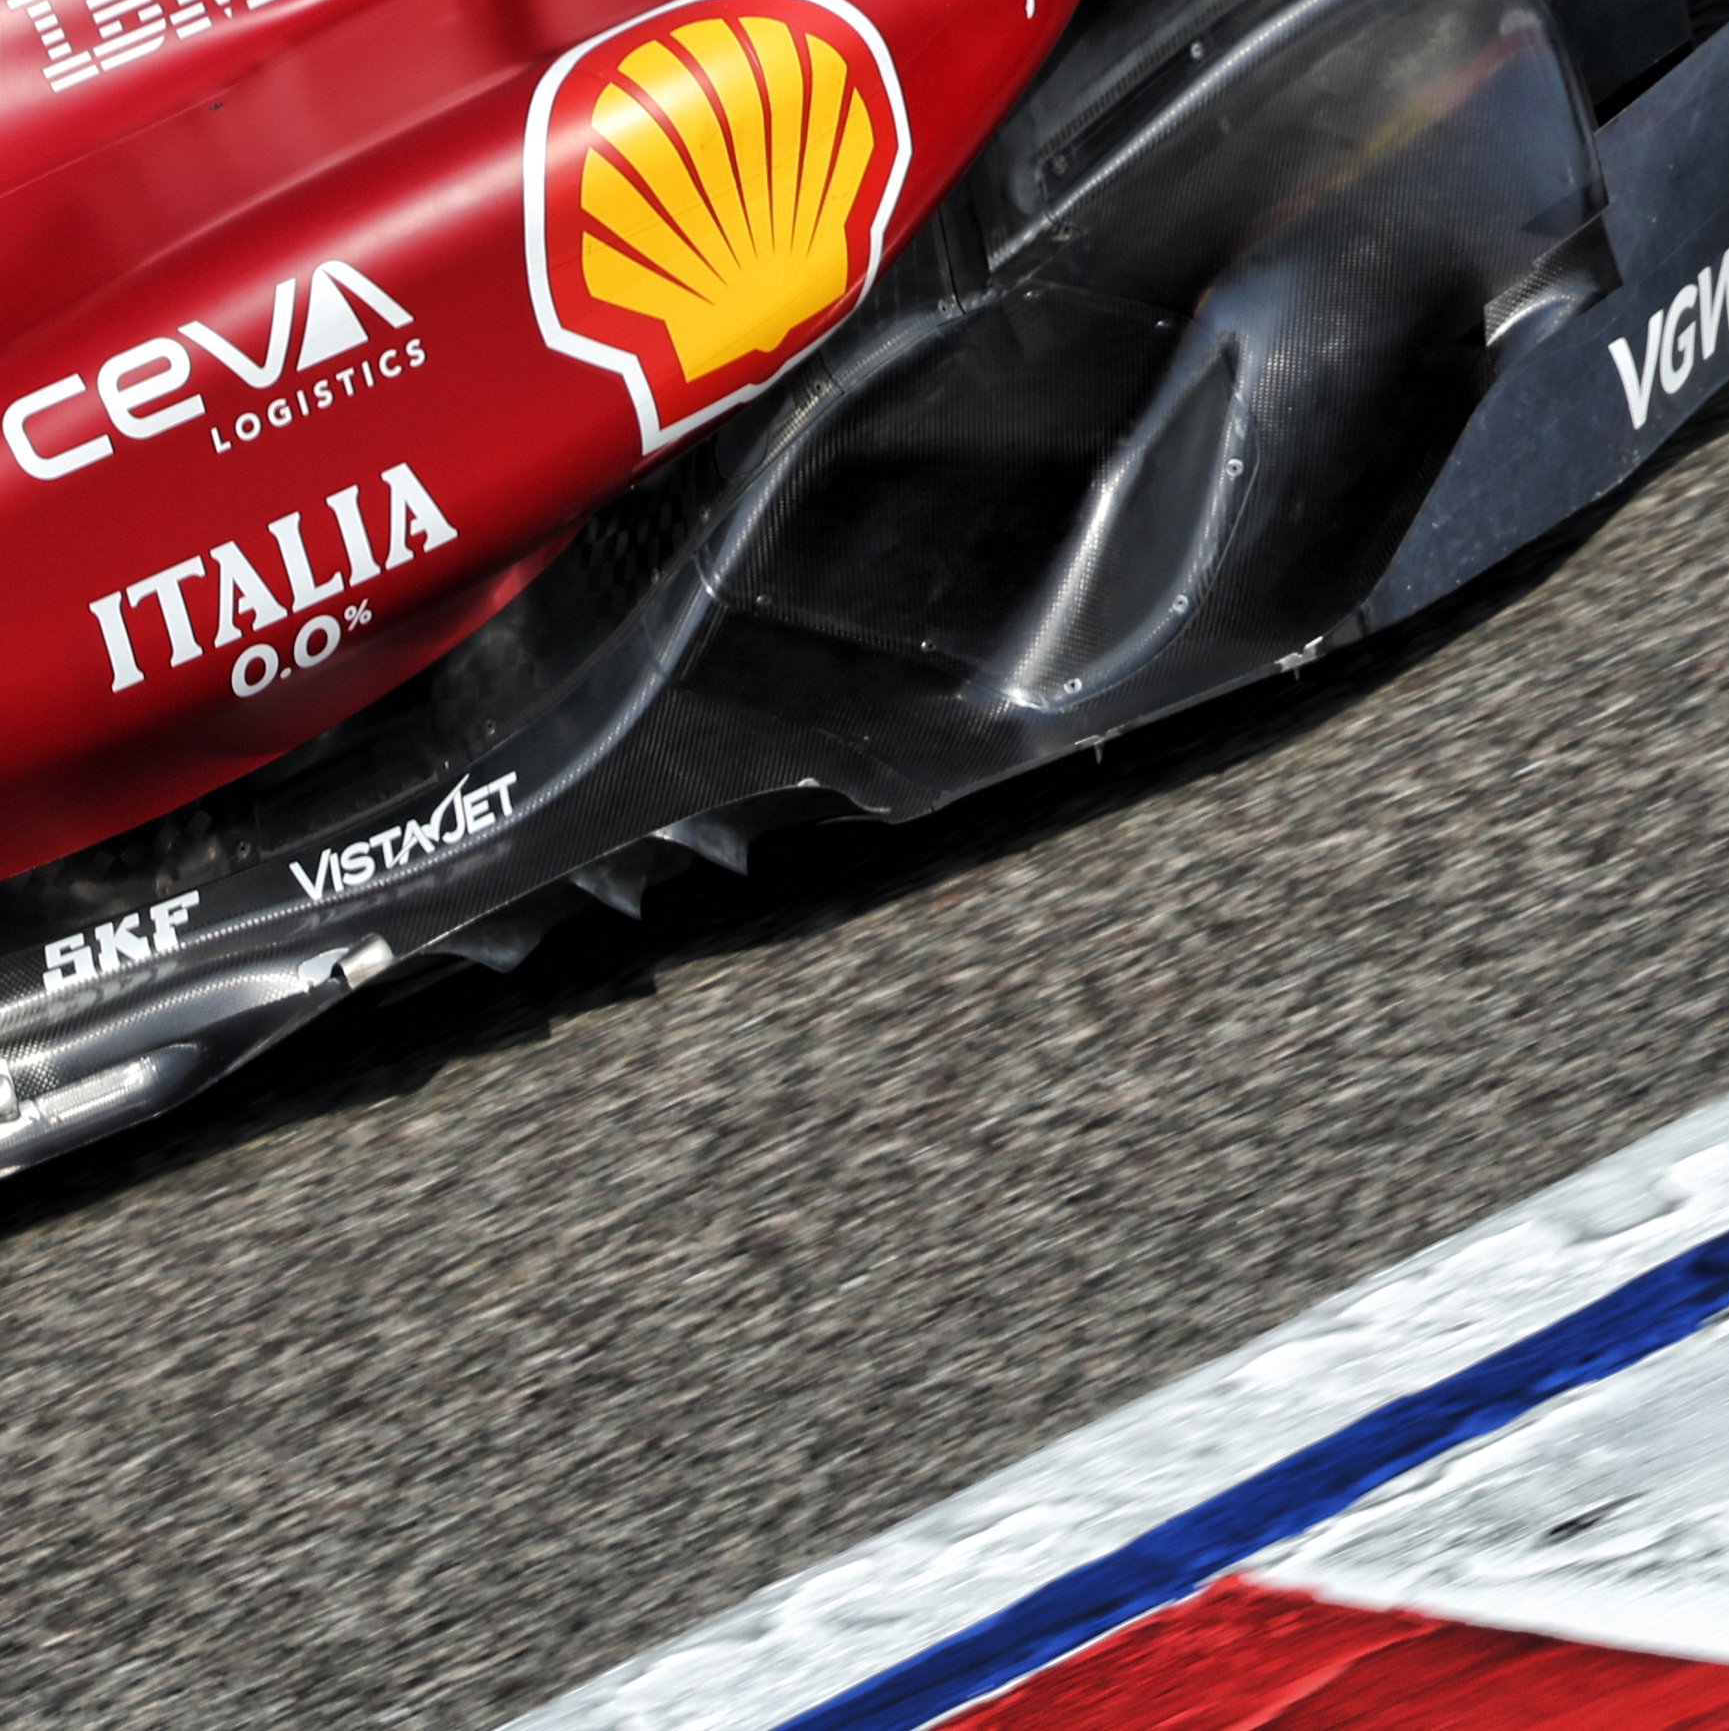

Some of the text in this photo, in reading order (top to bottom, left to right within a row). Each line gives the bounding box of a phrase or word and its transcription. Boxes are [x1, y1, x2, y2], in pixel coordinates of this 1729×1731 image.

[209, 337, 428, 454] LOGISTICS
[89, 462, 458, 693] ITALIA
[230, 597, 373, 699] 0.0%
[43, 890, 200, 993] SKF
